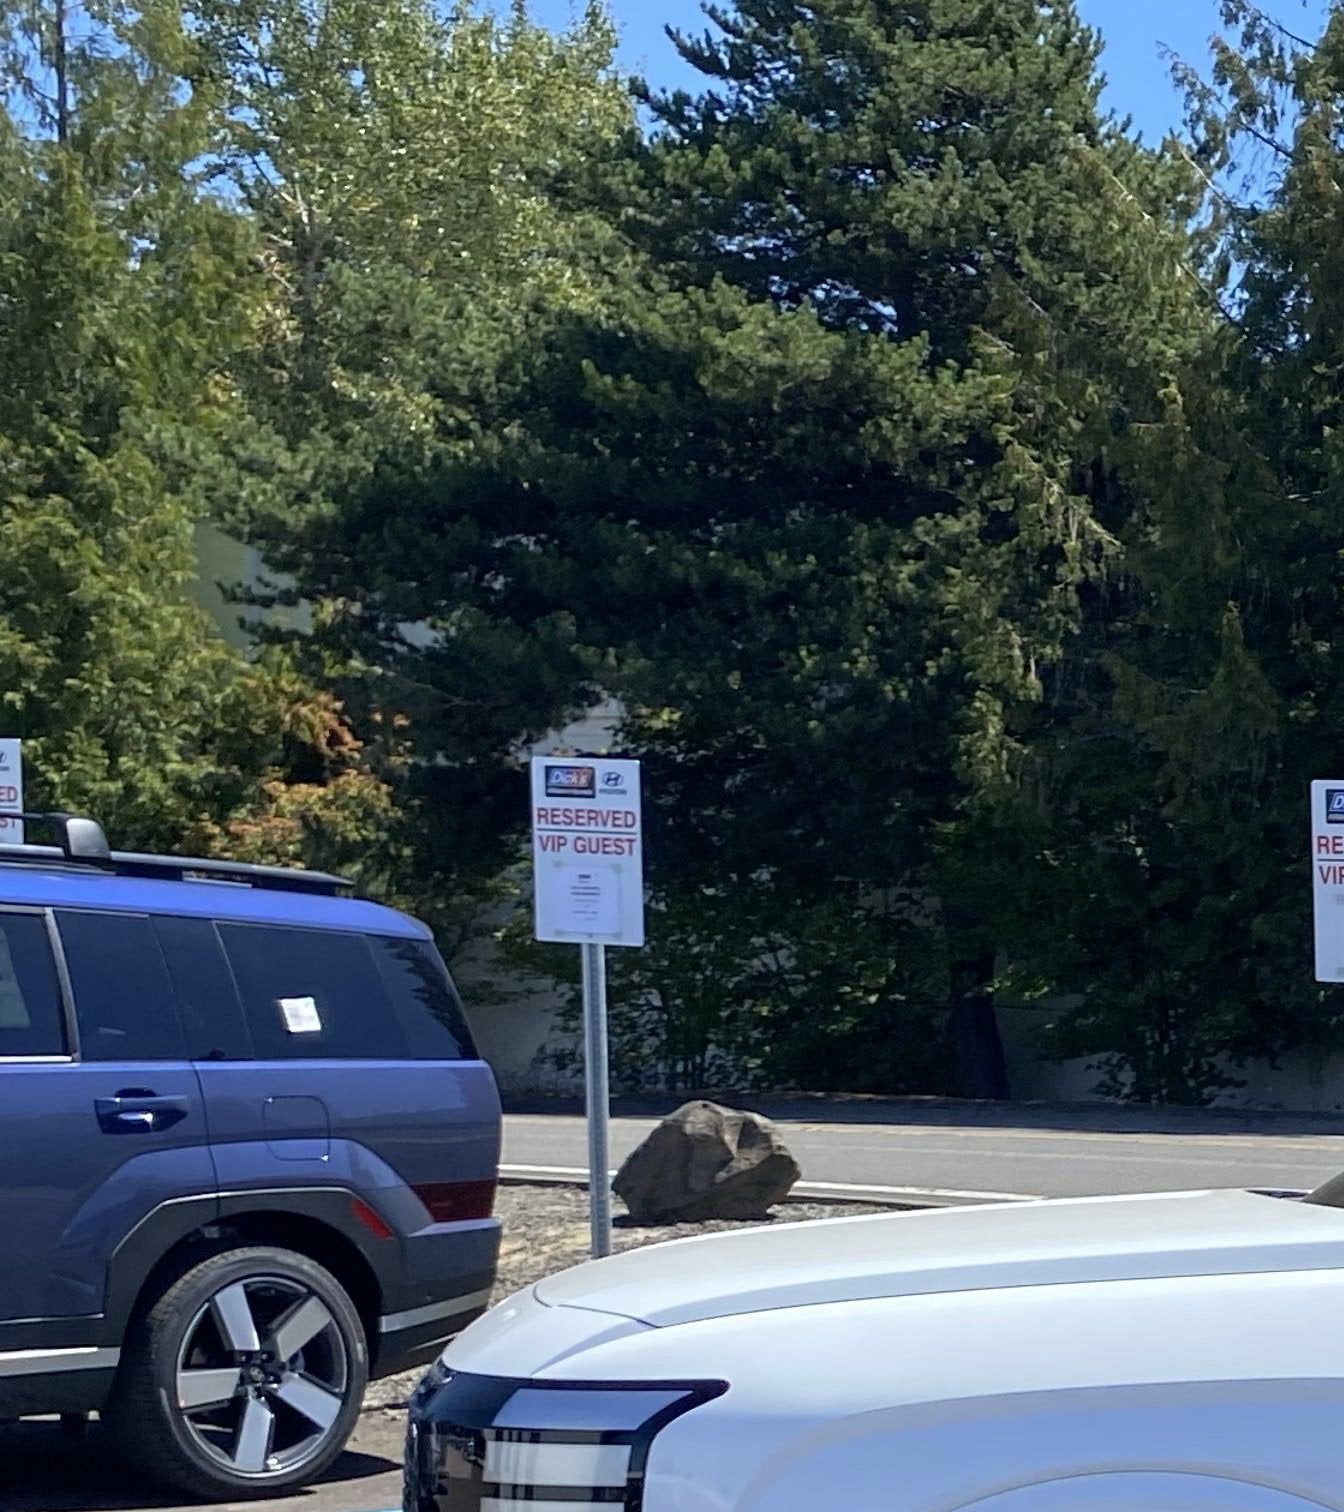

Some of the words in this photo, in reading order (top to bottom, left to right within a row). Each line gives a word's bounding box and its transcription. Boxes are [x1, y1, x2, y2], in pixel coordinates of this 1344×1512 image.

[537, 807, 636, 829] RESERVED
[538, 835, 568, 853] VIP
[574, 836, 636, 856] GUEST
